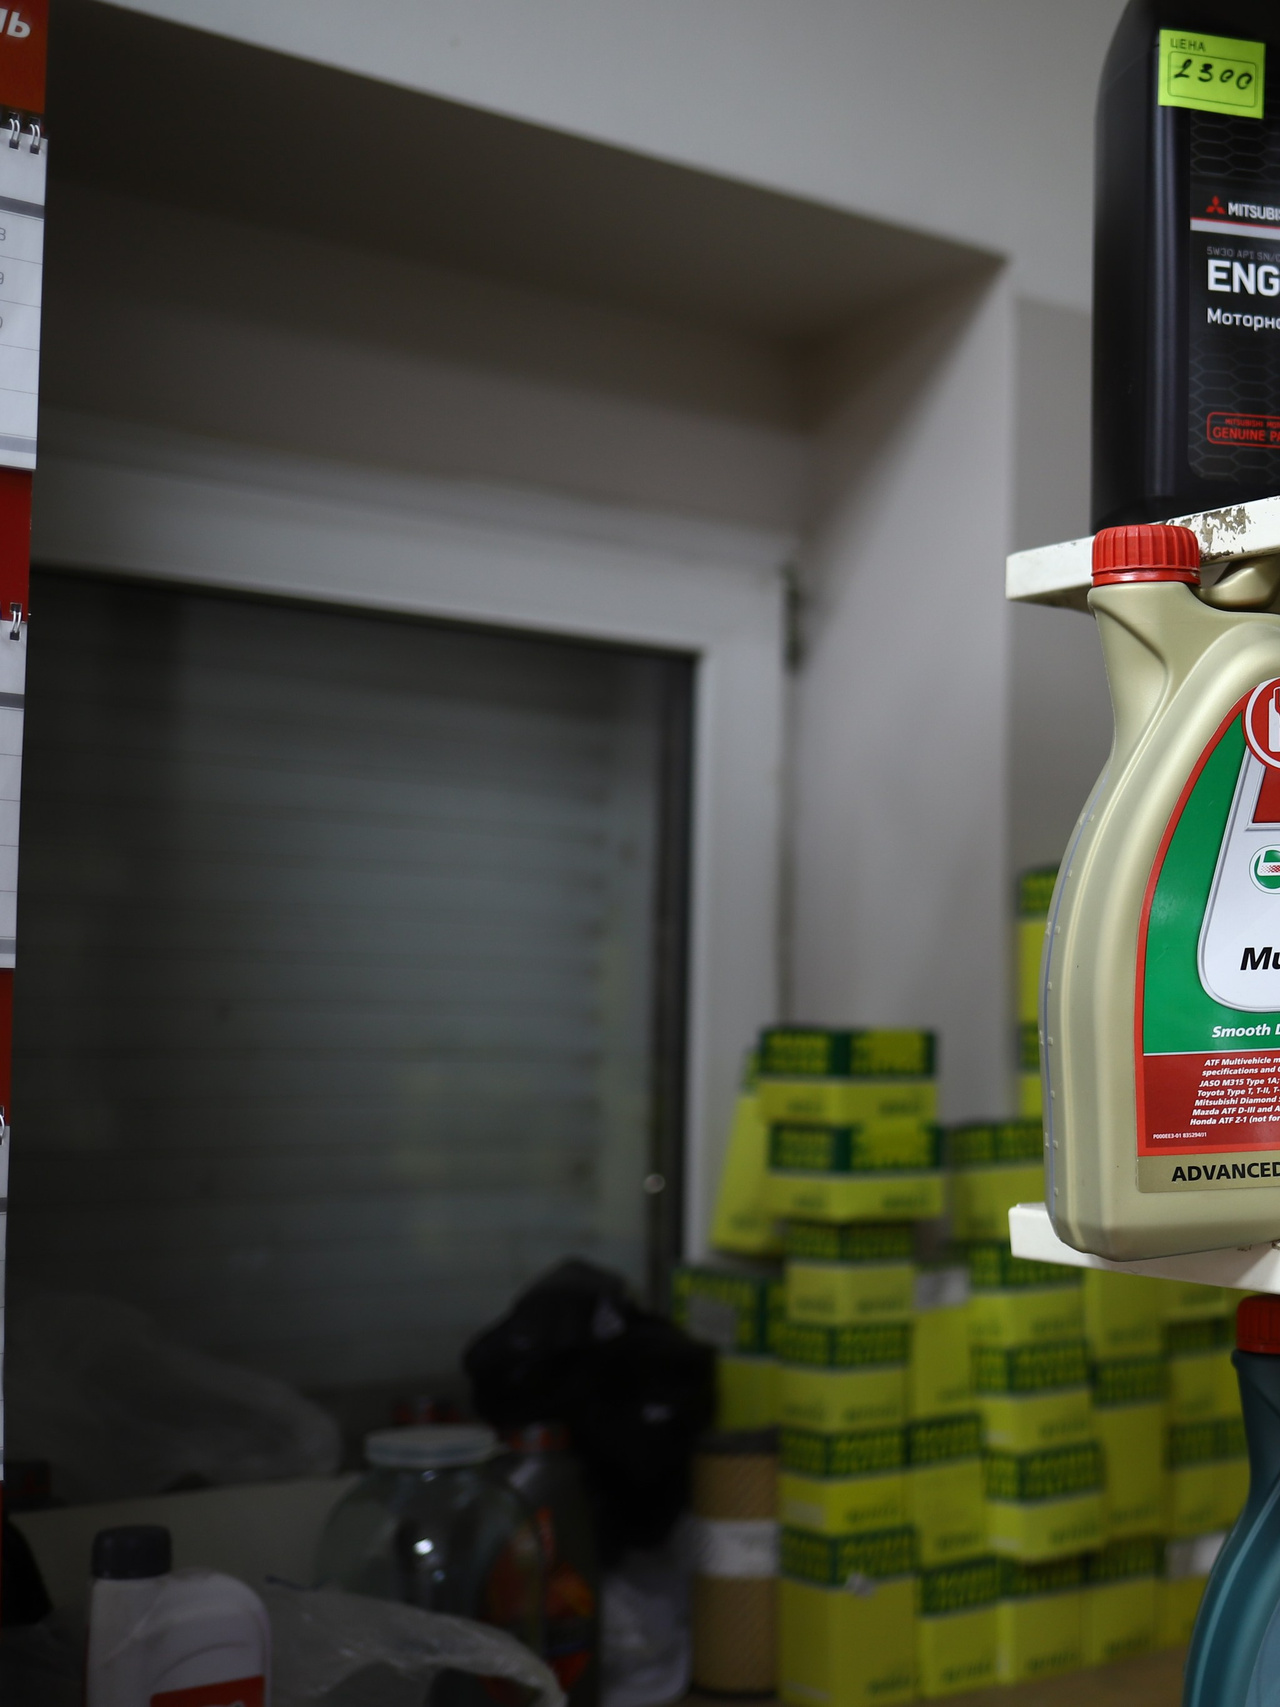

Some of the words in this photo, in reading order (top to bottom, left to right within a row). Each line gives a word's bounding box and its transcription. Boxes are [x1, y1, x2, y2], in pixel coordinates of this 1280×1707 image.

[1170, 38, 1206, 52] ЦЕНА
[1174, 59, 1252, 90] 2300
[1212, 427, 1265, 441] GENUINE
[1212, 1023, 1270, 1038] Smooth
[1221, 1057, 1271, 1066] Multivehicle
[1202, 1068, 1258, 1077] specifications
[1246, 1078, 1265, 1087] Type
[1197, 1090, 1225, 1098] Toyota
[1227, 1088, 1246, 1097] Type
[1195, 1098, 1238, 1106] Mitsubishi
[1240, 1096, 1277, 1105] Diamond
[1238, 1106, 1256, 1114] D-III
[1249, 1115, 1267, 1124] (not
